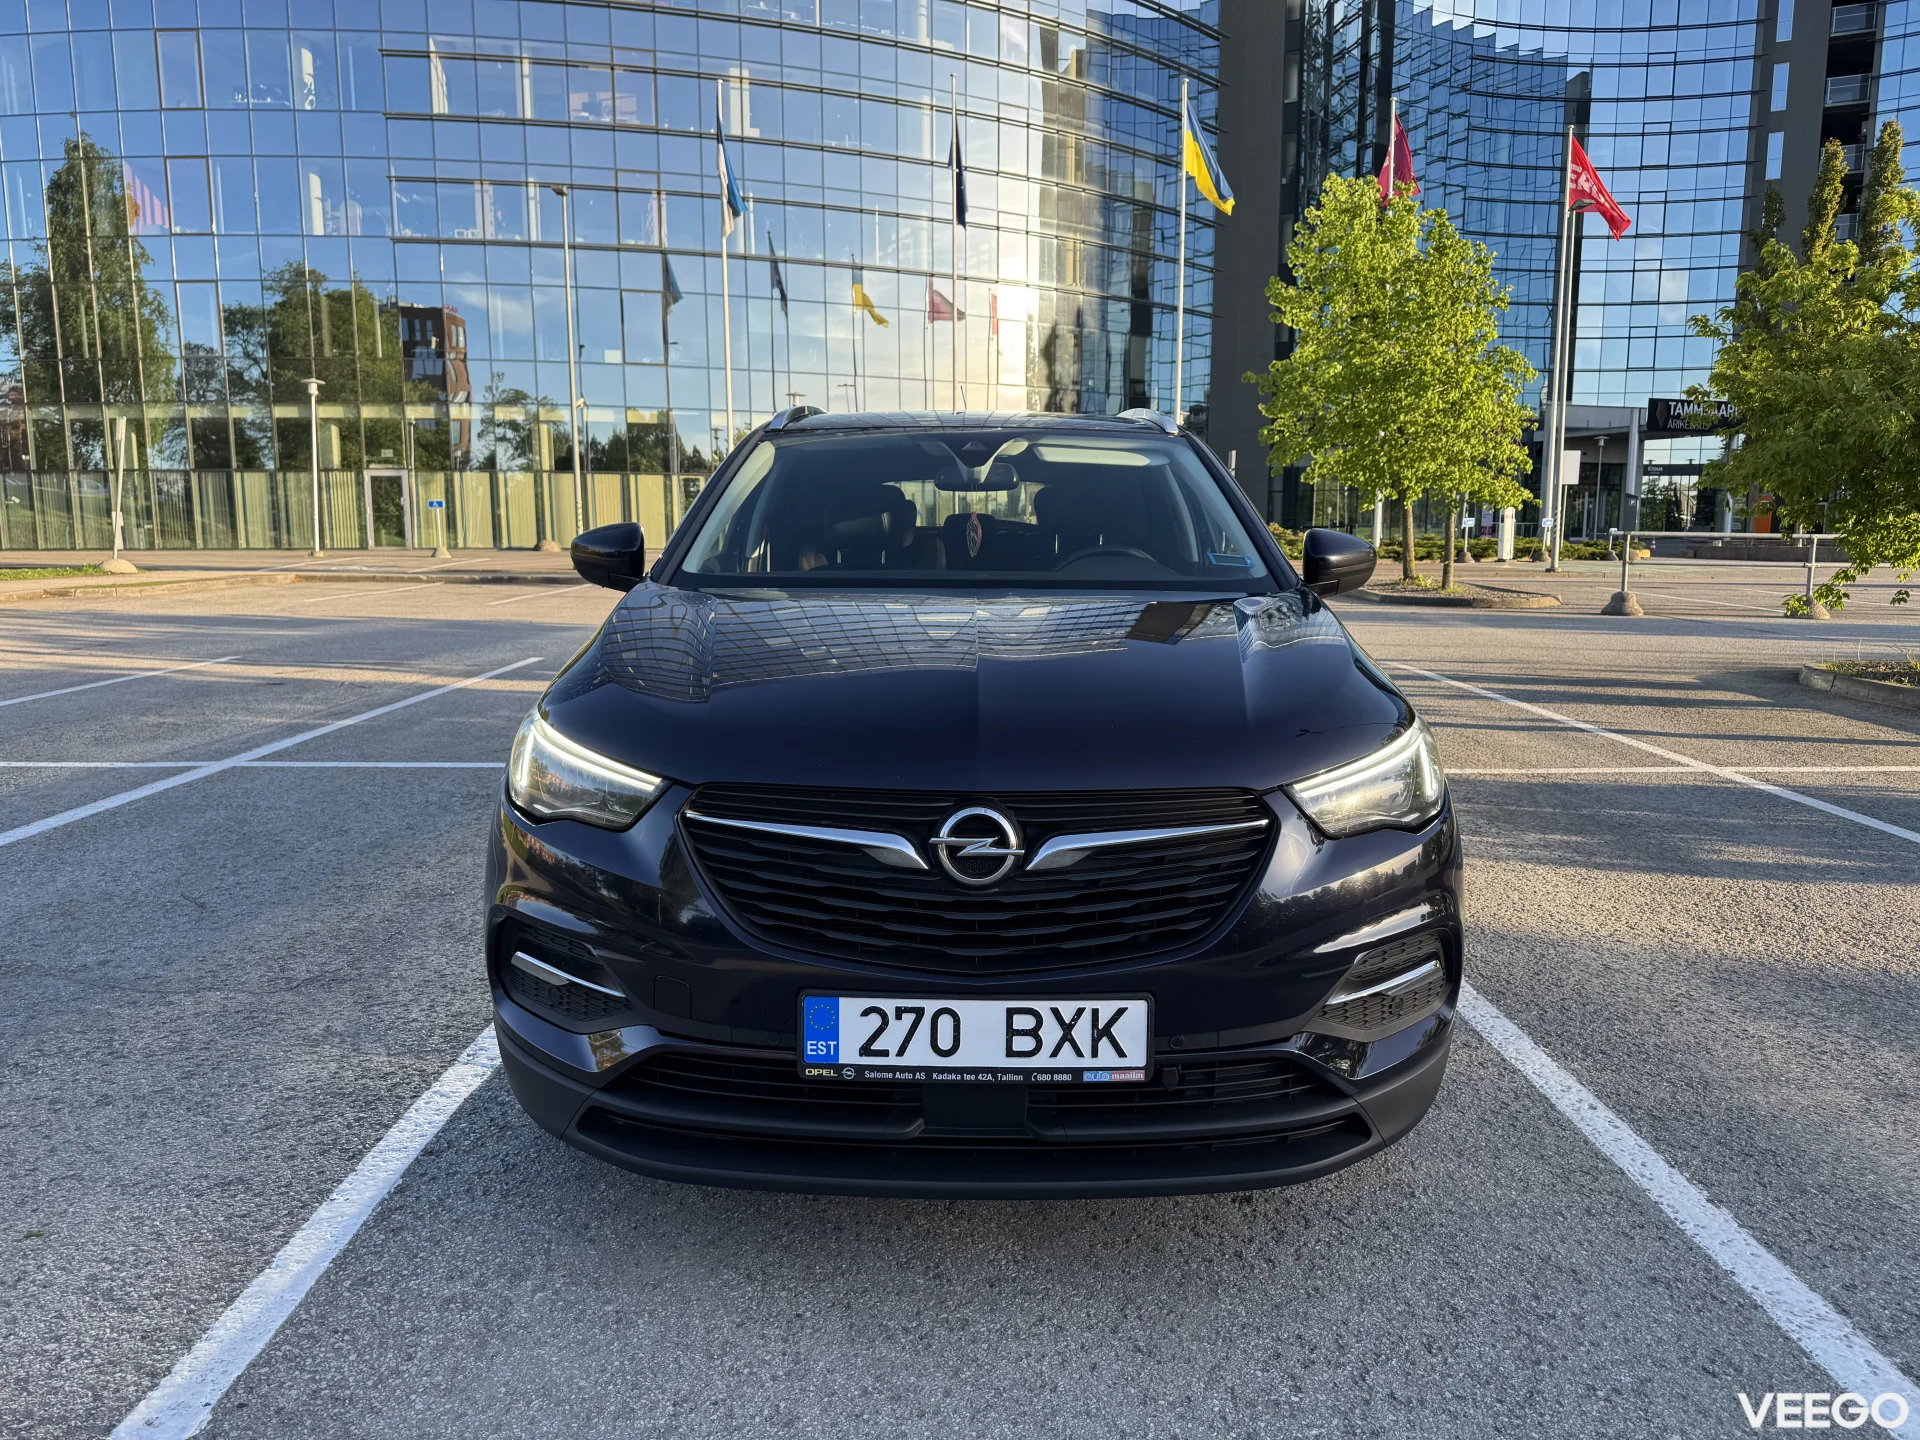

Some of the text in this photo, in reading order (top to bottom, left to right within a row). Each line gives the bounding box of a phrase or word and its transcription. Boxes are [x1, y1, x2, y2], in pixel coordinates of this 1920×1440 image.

[858, 1005, 1129, 1059] 270 BXK
[806, 1040, 838, 1056] EST
[805, 1068, 838, 1077] OPEL
[864, 1070, 893, 1079] Salome
[895, 1071, 913, 1080] Auto
[915, 1072, 926, 1080] AS
[932, 1072, 961, 1081] Kadaka
[963, 1072, 976, 1081] tee
[977, 1073, 995, 1082] 42A,
[996, 1073, 1023, 1081] Tallinn
